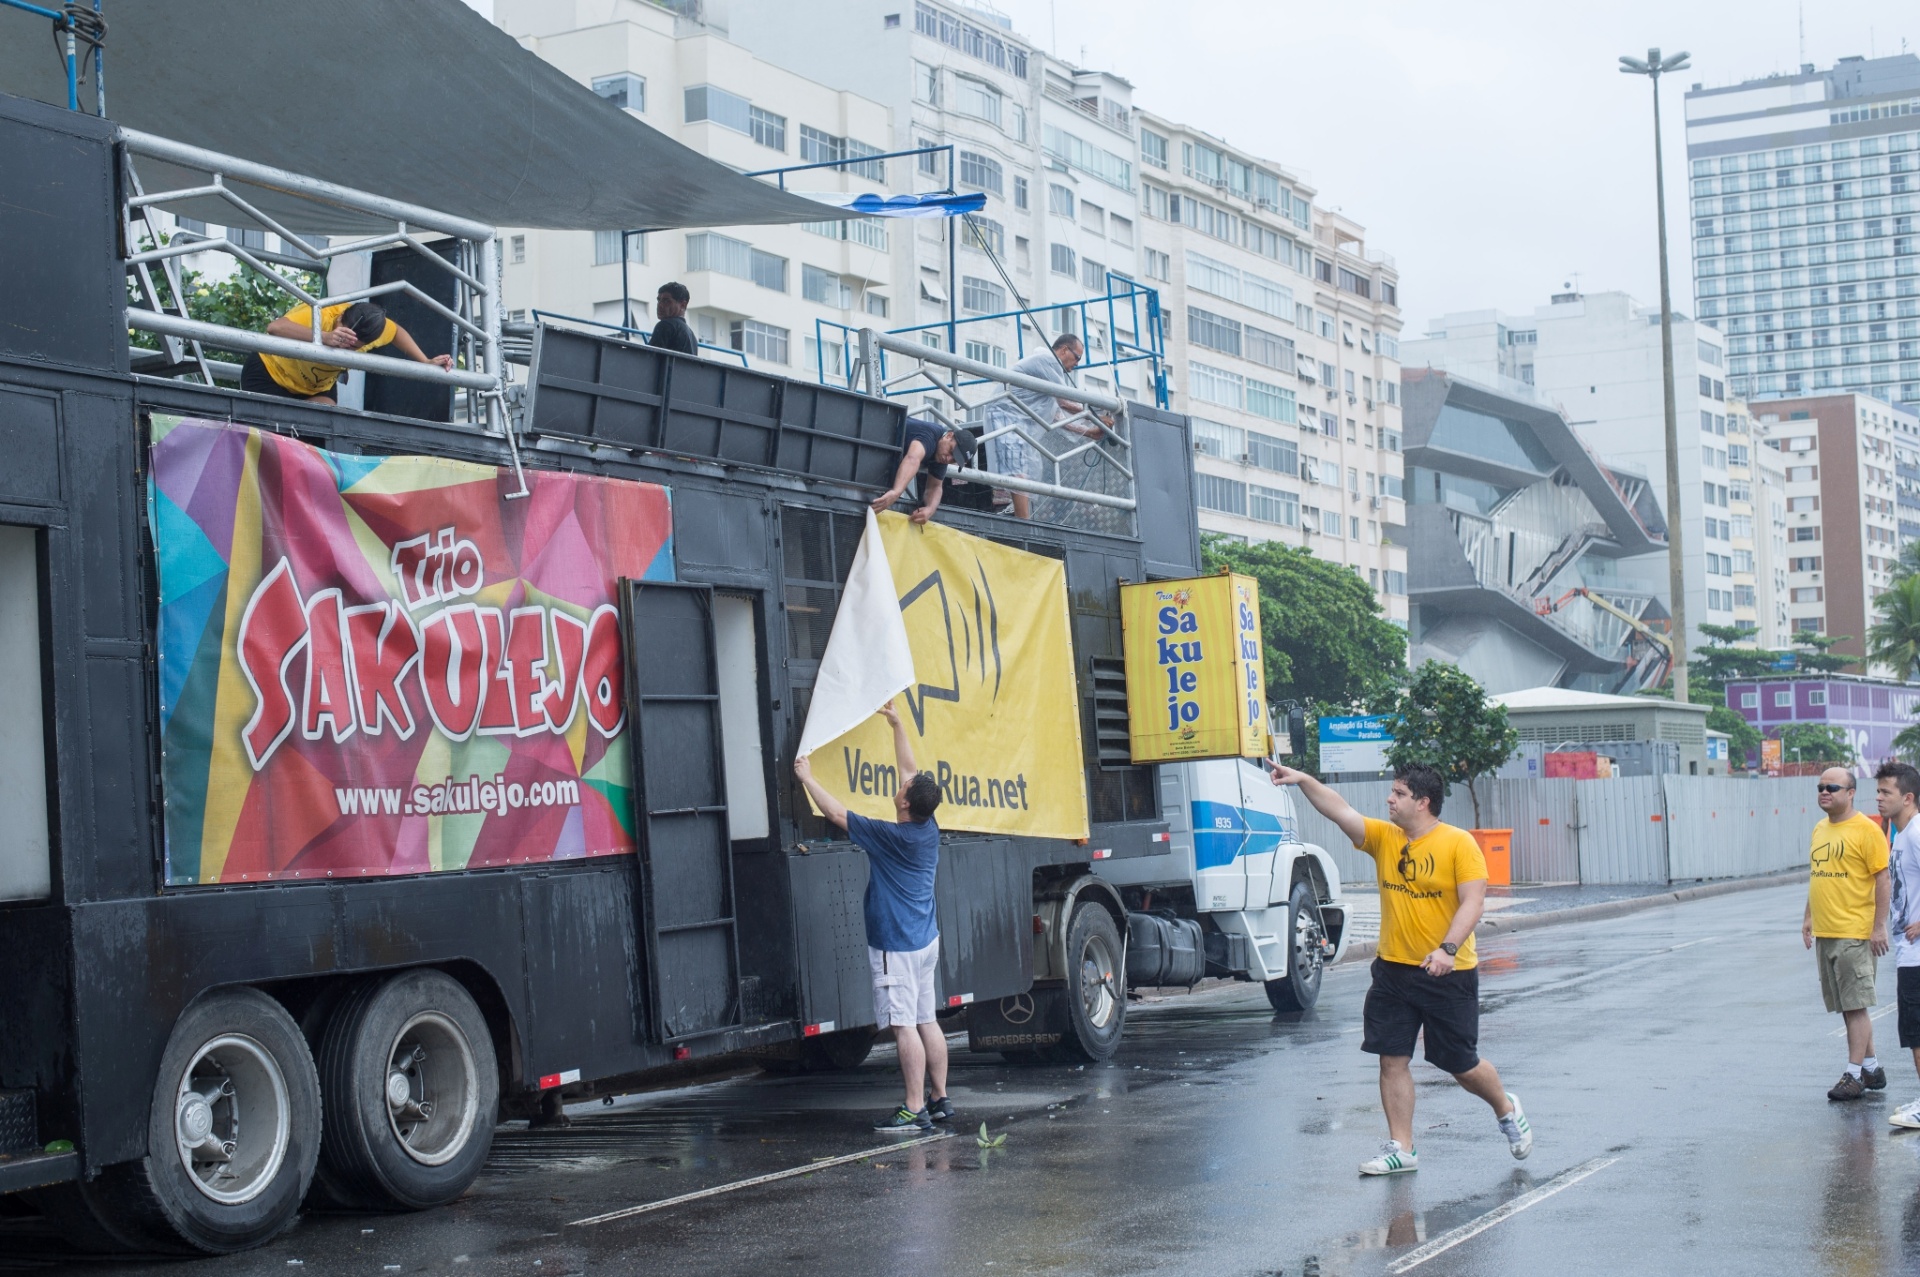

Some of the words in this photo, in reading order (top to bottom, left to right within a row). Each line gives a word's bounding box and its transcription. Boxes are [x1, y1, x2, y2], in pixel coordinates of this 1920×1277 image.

[391, 526, 483, 612] Trio
[1156, 590, 1173, 601] Trio
[1158, 606, 1199, 635] Sa
[236, 555, 627, 771] SAKULEJO
[1157, 637, 1203, 665] ku
[1166, 666, 1197, 694] le
[1168, 696, 1200, 731] jo
[844, 746, 1028, 810] VemRua.net
[336, 776, 580, 816] www.sakulejo.com
[1215, 817, 1232, 829] 1935
